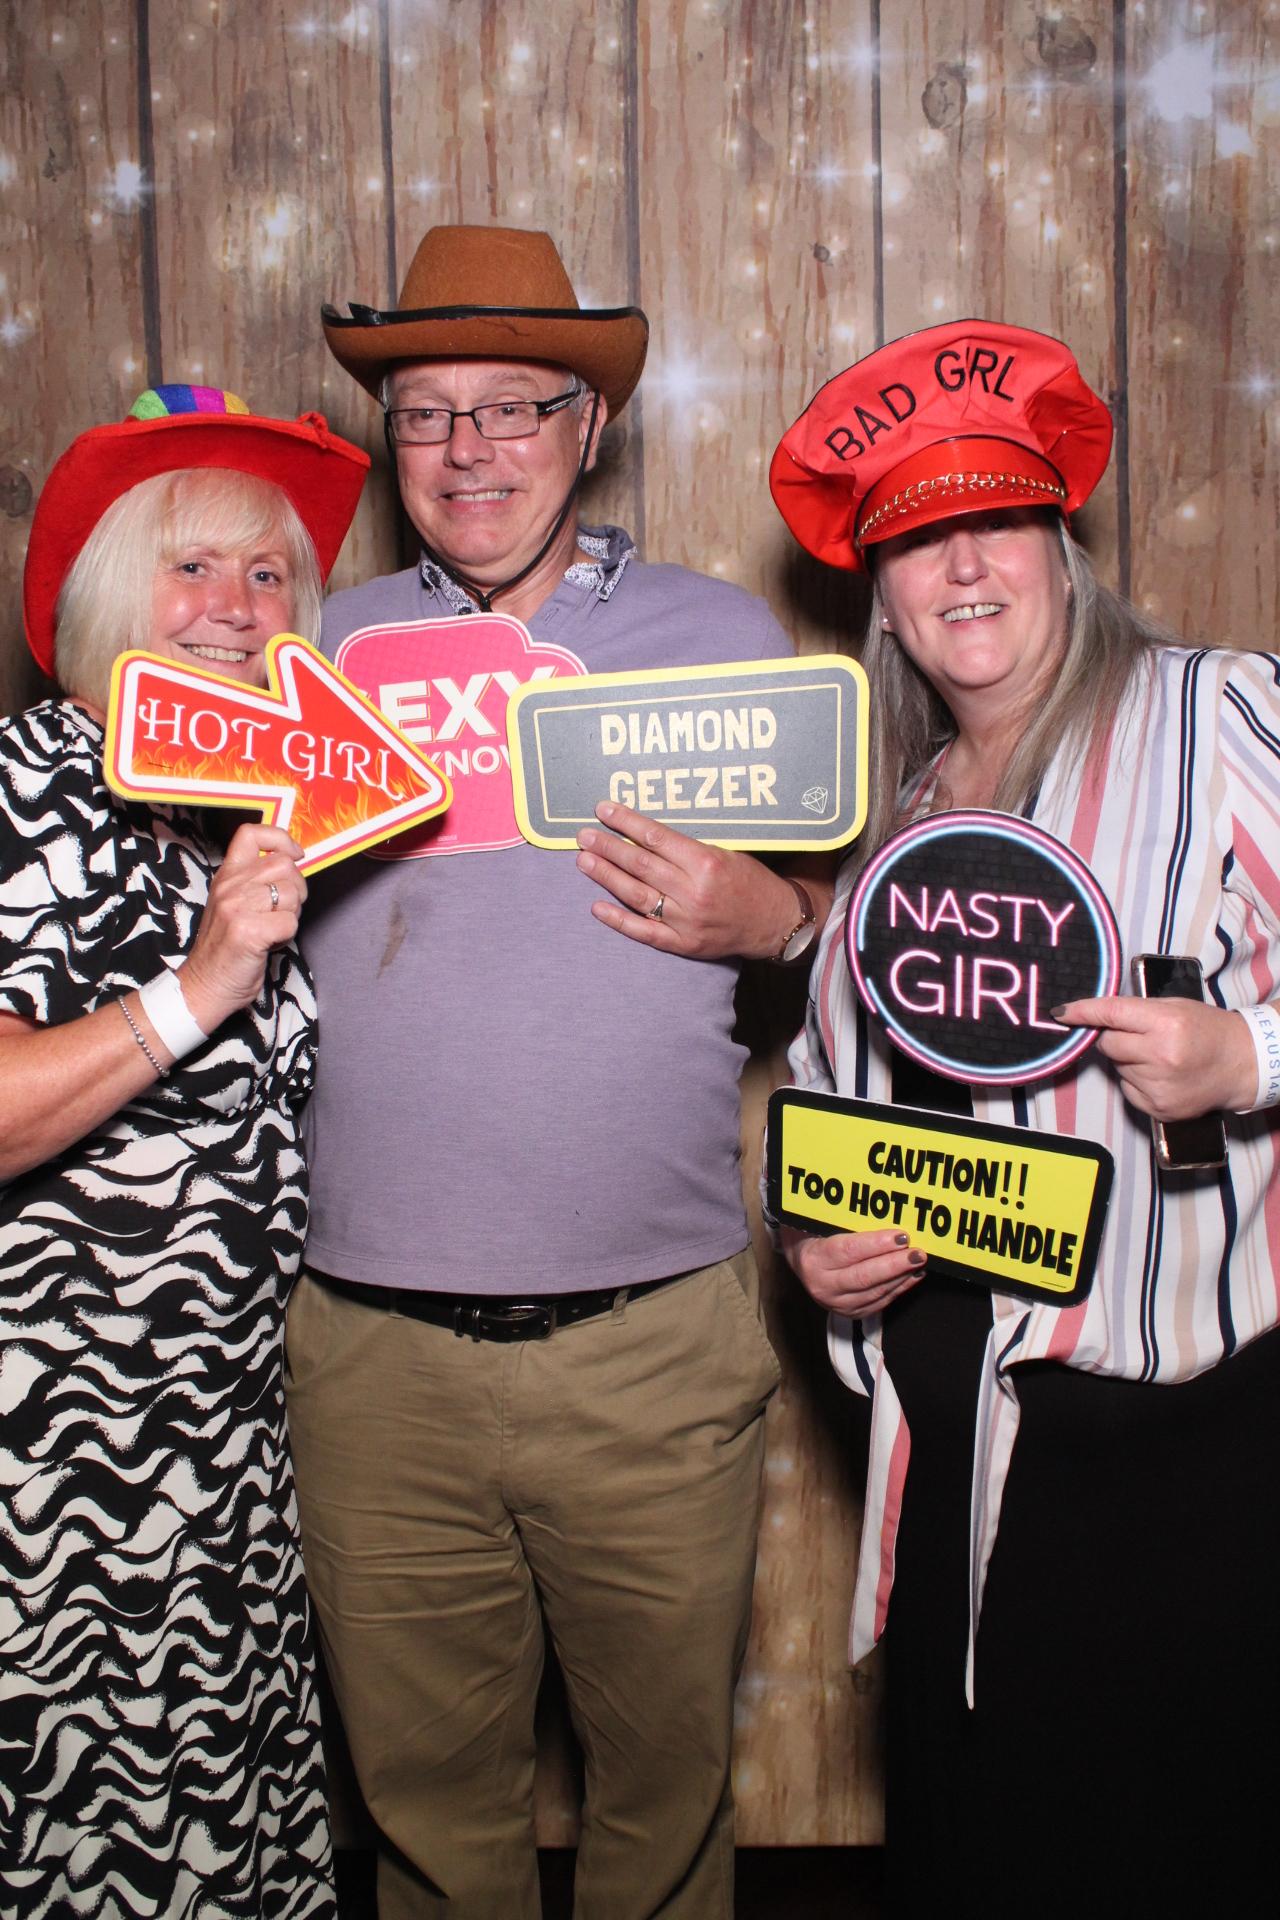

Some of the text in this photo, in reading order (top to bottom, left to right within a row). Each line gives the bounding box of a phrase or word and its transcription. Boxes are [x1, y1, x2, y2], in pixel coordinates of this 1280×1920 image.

[824, 383, 917, 461] BAD
[138, 698, 404, 801] HOT GIRL
[601, 707, 777, 756] DIAMOND
[609, 764, 778, 811] GEEZER
[890, 883, 1075, 947] NASTY
[889, 949, 1071, 1032] GIRL
[867, 1141, 1029, 1210] CAUTION!!
[788, 1165, 1078, 1277] TOO HOT TO HANDLE
